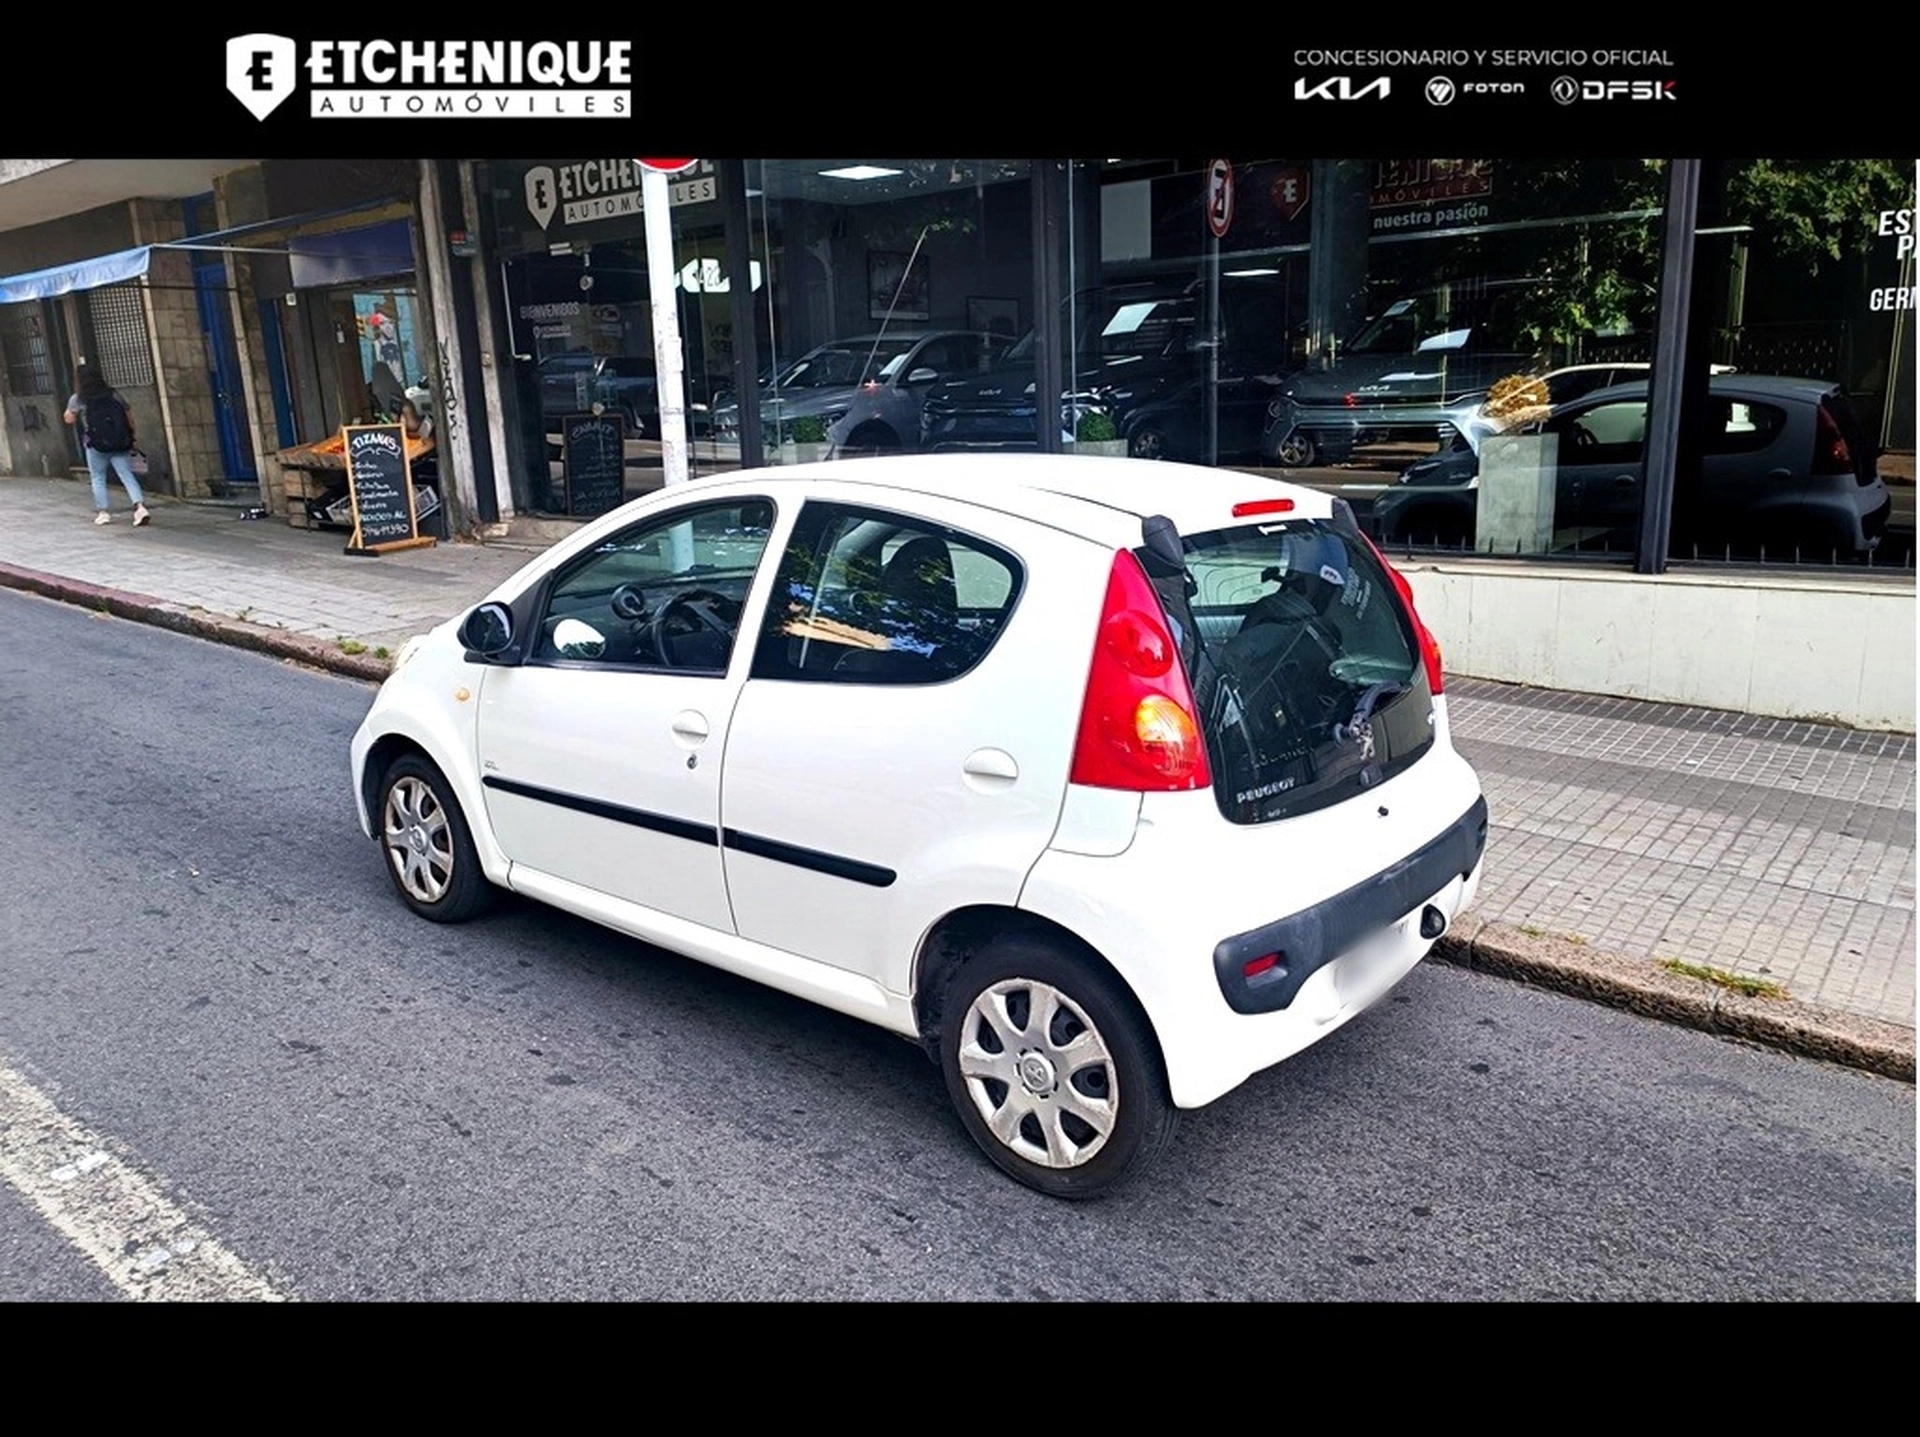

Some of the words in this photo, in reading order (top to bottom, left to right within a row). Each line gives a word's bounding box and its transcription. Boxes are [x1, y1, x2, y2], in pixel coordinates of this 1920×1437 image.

[1373, 210, 1432, 229] nuestra
[1435, 201, 1489, 226] pasión
[1897, 234, 1916, 260] P
[1236, 777, 1296, 804] PEUGEOT
